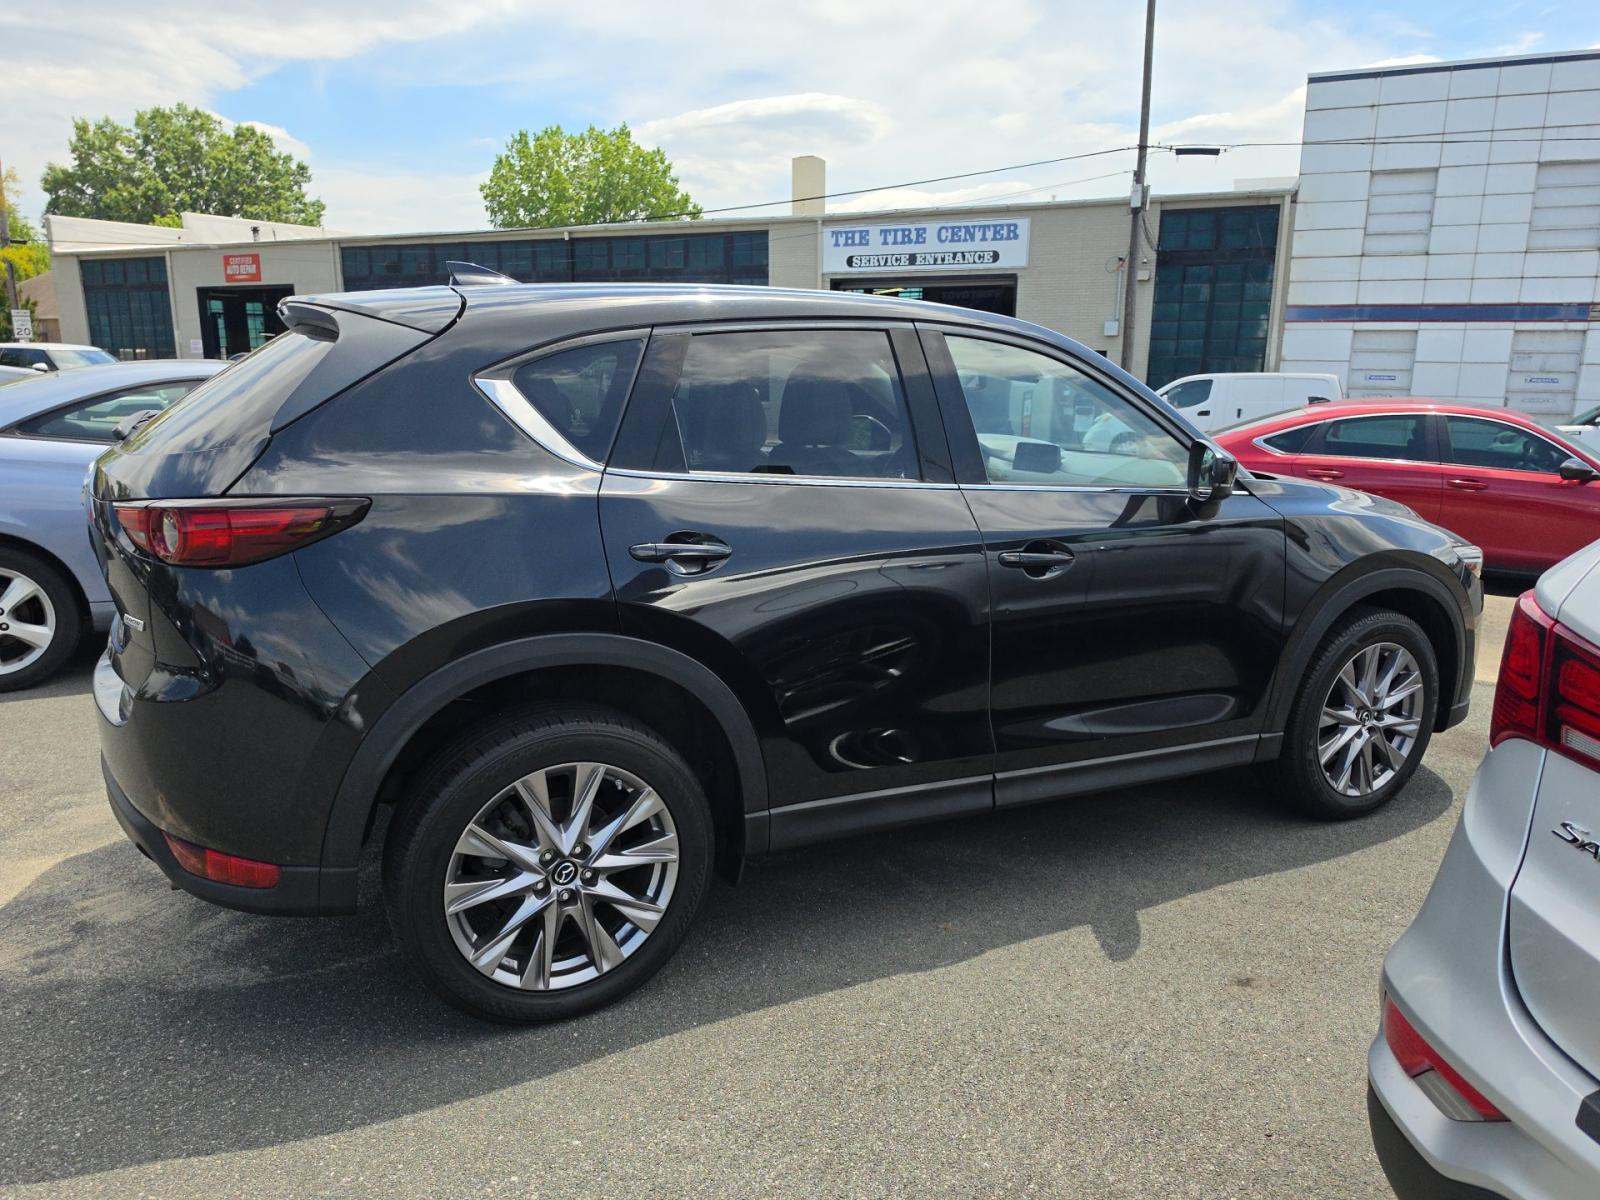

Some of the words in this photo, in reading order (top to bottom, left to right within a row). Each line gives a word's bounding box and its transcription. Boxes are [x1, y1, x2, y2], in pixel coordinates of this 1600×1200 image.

[831, 230, 870, 247] THE
[880, 227, 927, 245] TIRE
[937, 223, 1019, 243] CENTER
[852, 253, 910, 267] SERVICE
[915, 251, 993, 265] ENTRANCE
[16, 327, 31, 336] 20
[1551, 821, 1600, 860] SA
